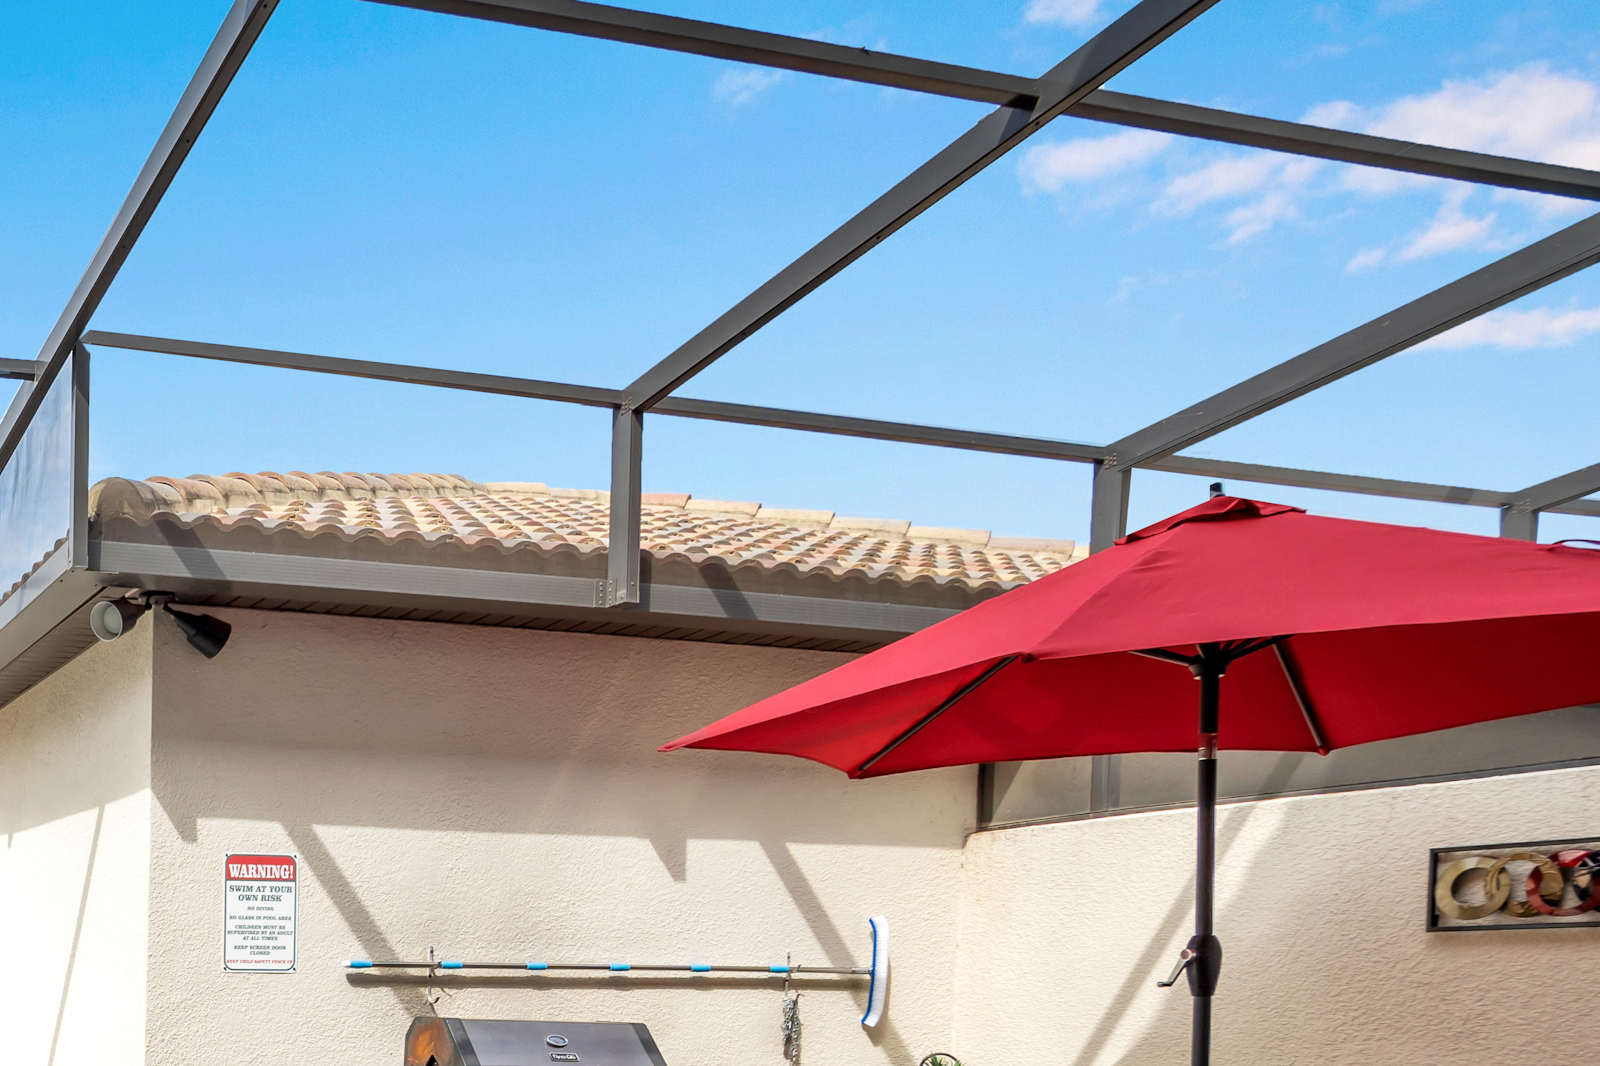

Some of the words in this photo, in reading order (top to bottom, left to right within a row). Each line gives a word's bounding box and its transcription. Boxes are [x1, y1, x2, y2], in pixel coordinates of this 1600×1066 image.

[228, 864, 293, 879] WARNING!
[229, 885, 253, 893] SWIM
[256, 885, 267, 893] AT
[261, 894, 282, 902] RISK
